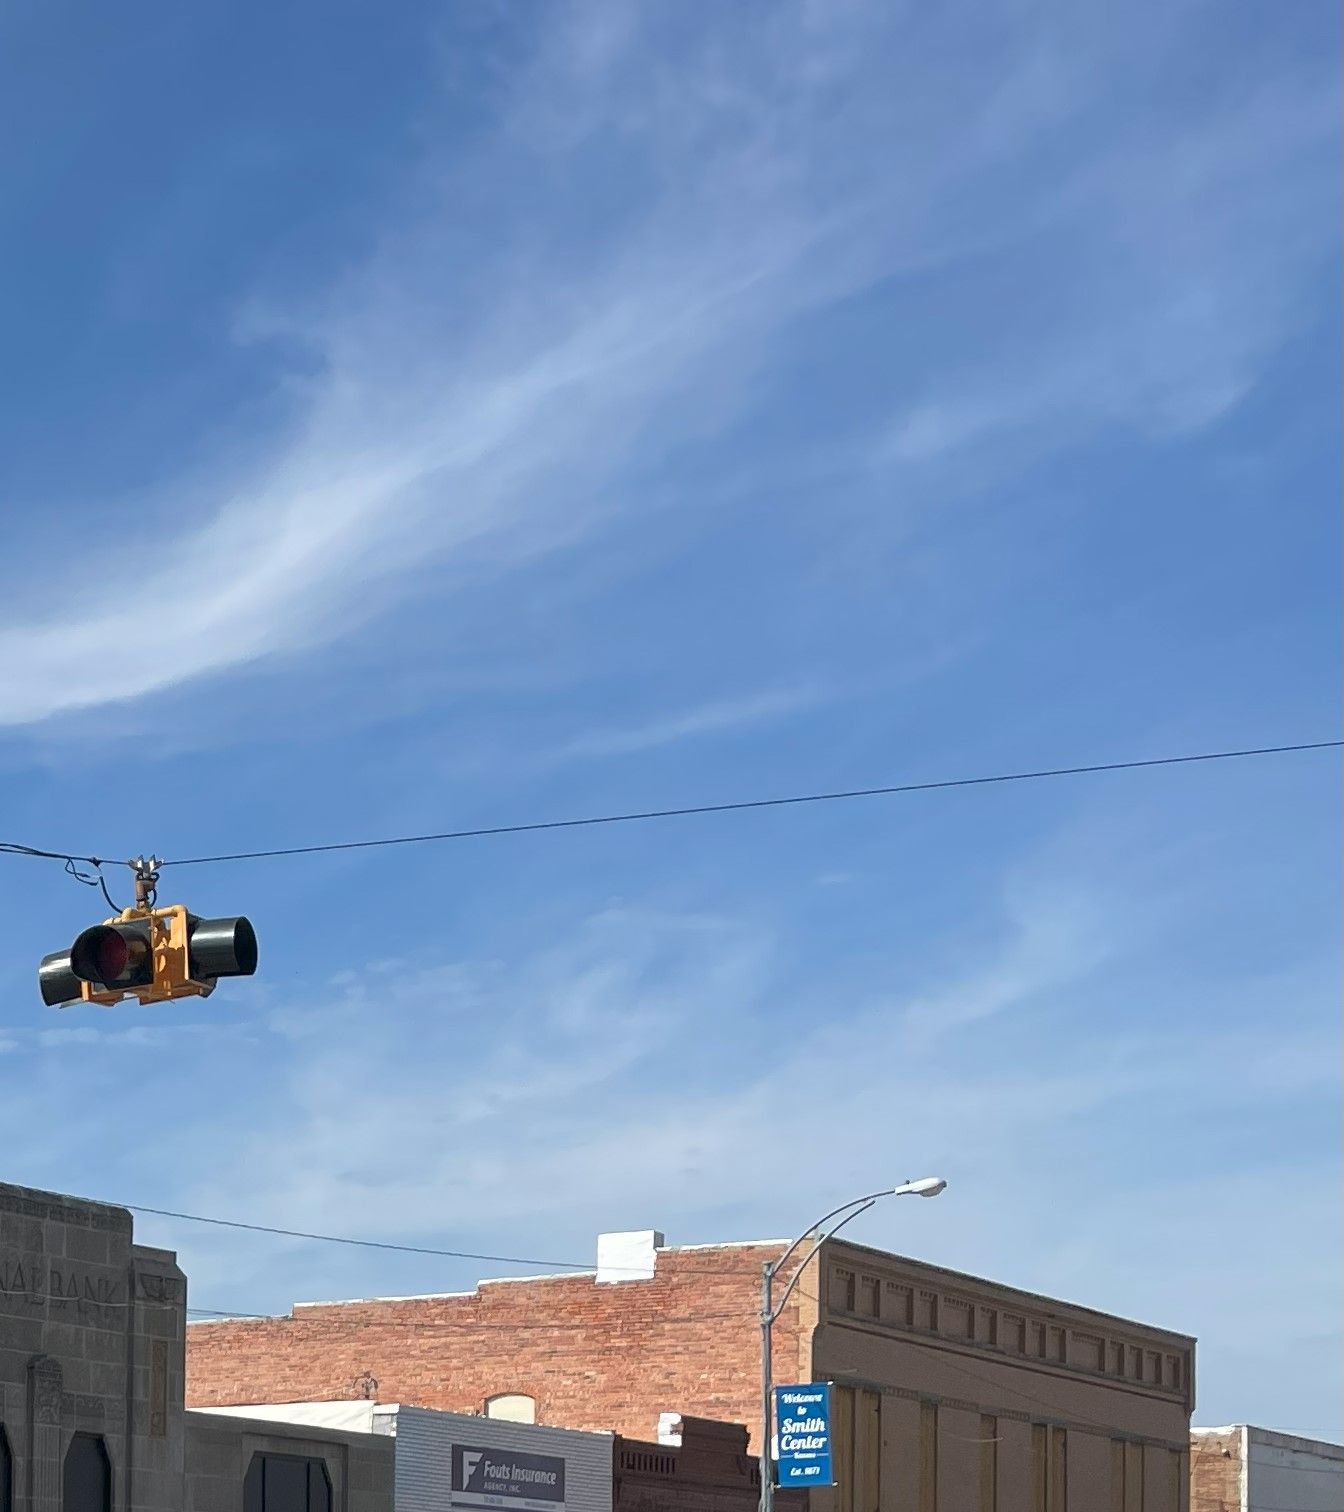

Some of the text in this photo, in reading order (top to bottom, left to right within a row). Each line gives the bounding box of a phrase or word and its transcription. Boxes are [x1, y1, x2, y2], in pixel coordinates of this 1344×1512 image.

[797, 1405, 808, 1416] to
[782, 1417, 826, 1434] Smith
[781, 1434, 827, 1451] Center
[484, 1460, 557, 1486] Fouts Insurance
